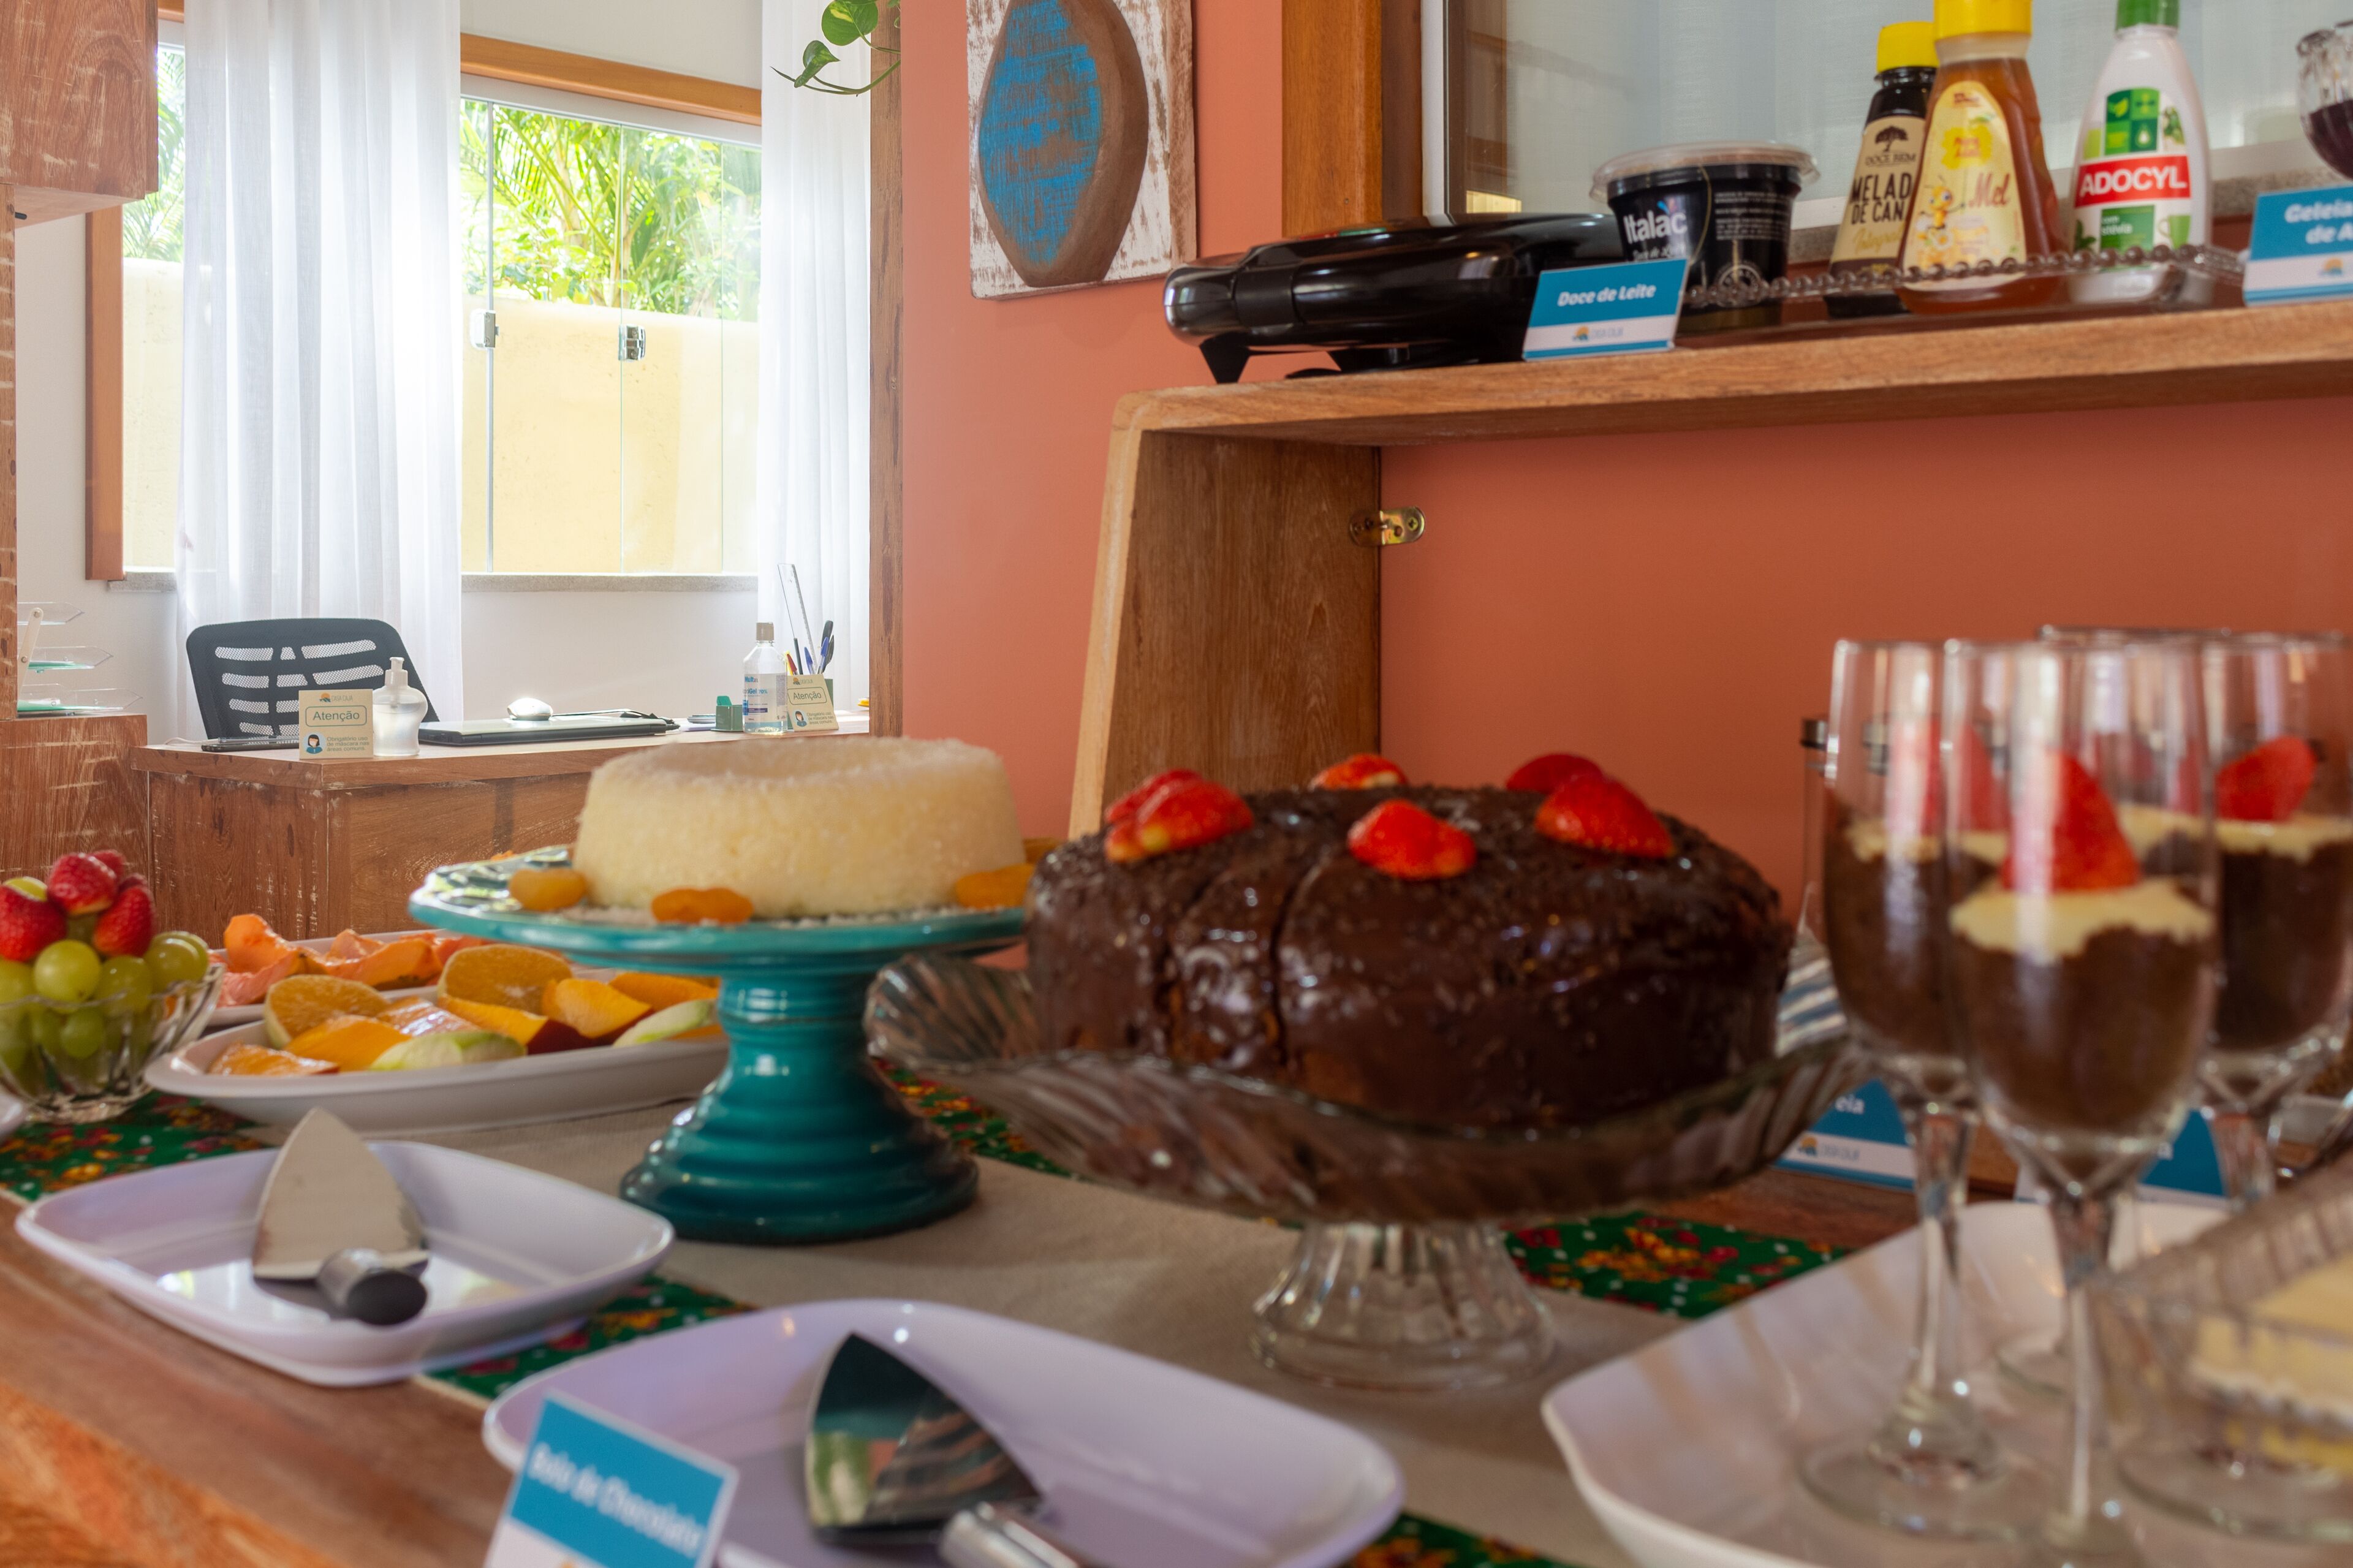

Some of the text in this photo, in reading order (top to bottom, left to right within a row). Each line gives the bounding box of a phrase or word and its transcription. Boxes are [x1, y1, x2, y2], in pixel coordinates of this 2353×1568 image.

[1851, 173, 1912, 202] MELAD
[1968, 172, 2010, 208] Mel
[2079, 165, 2188, 197] ADOCYL
[1851, 201, 1905, 225] DE CAN
[1623, 210, 1688, 244] Italac
[2305, 224, 2336, 244] de
[1557, 283, 1657, 307] Doce de Leite
[793, 691, 822, 701] Atenção
[313, 711, 360, 722] Atenção
